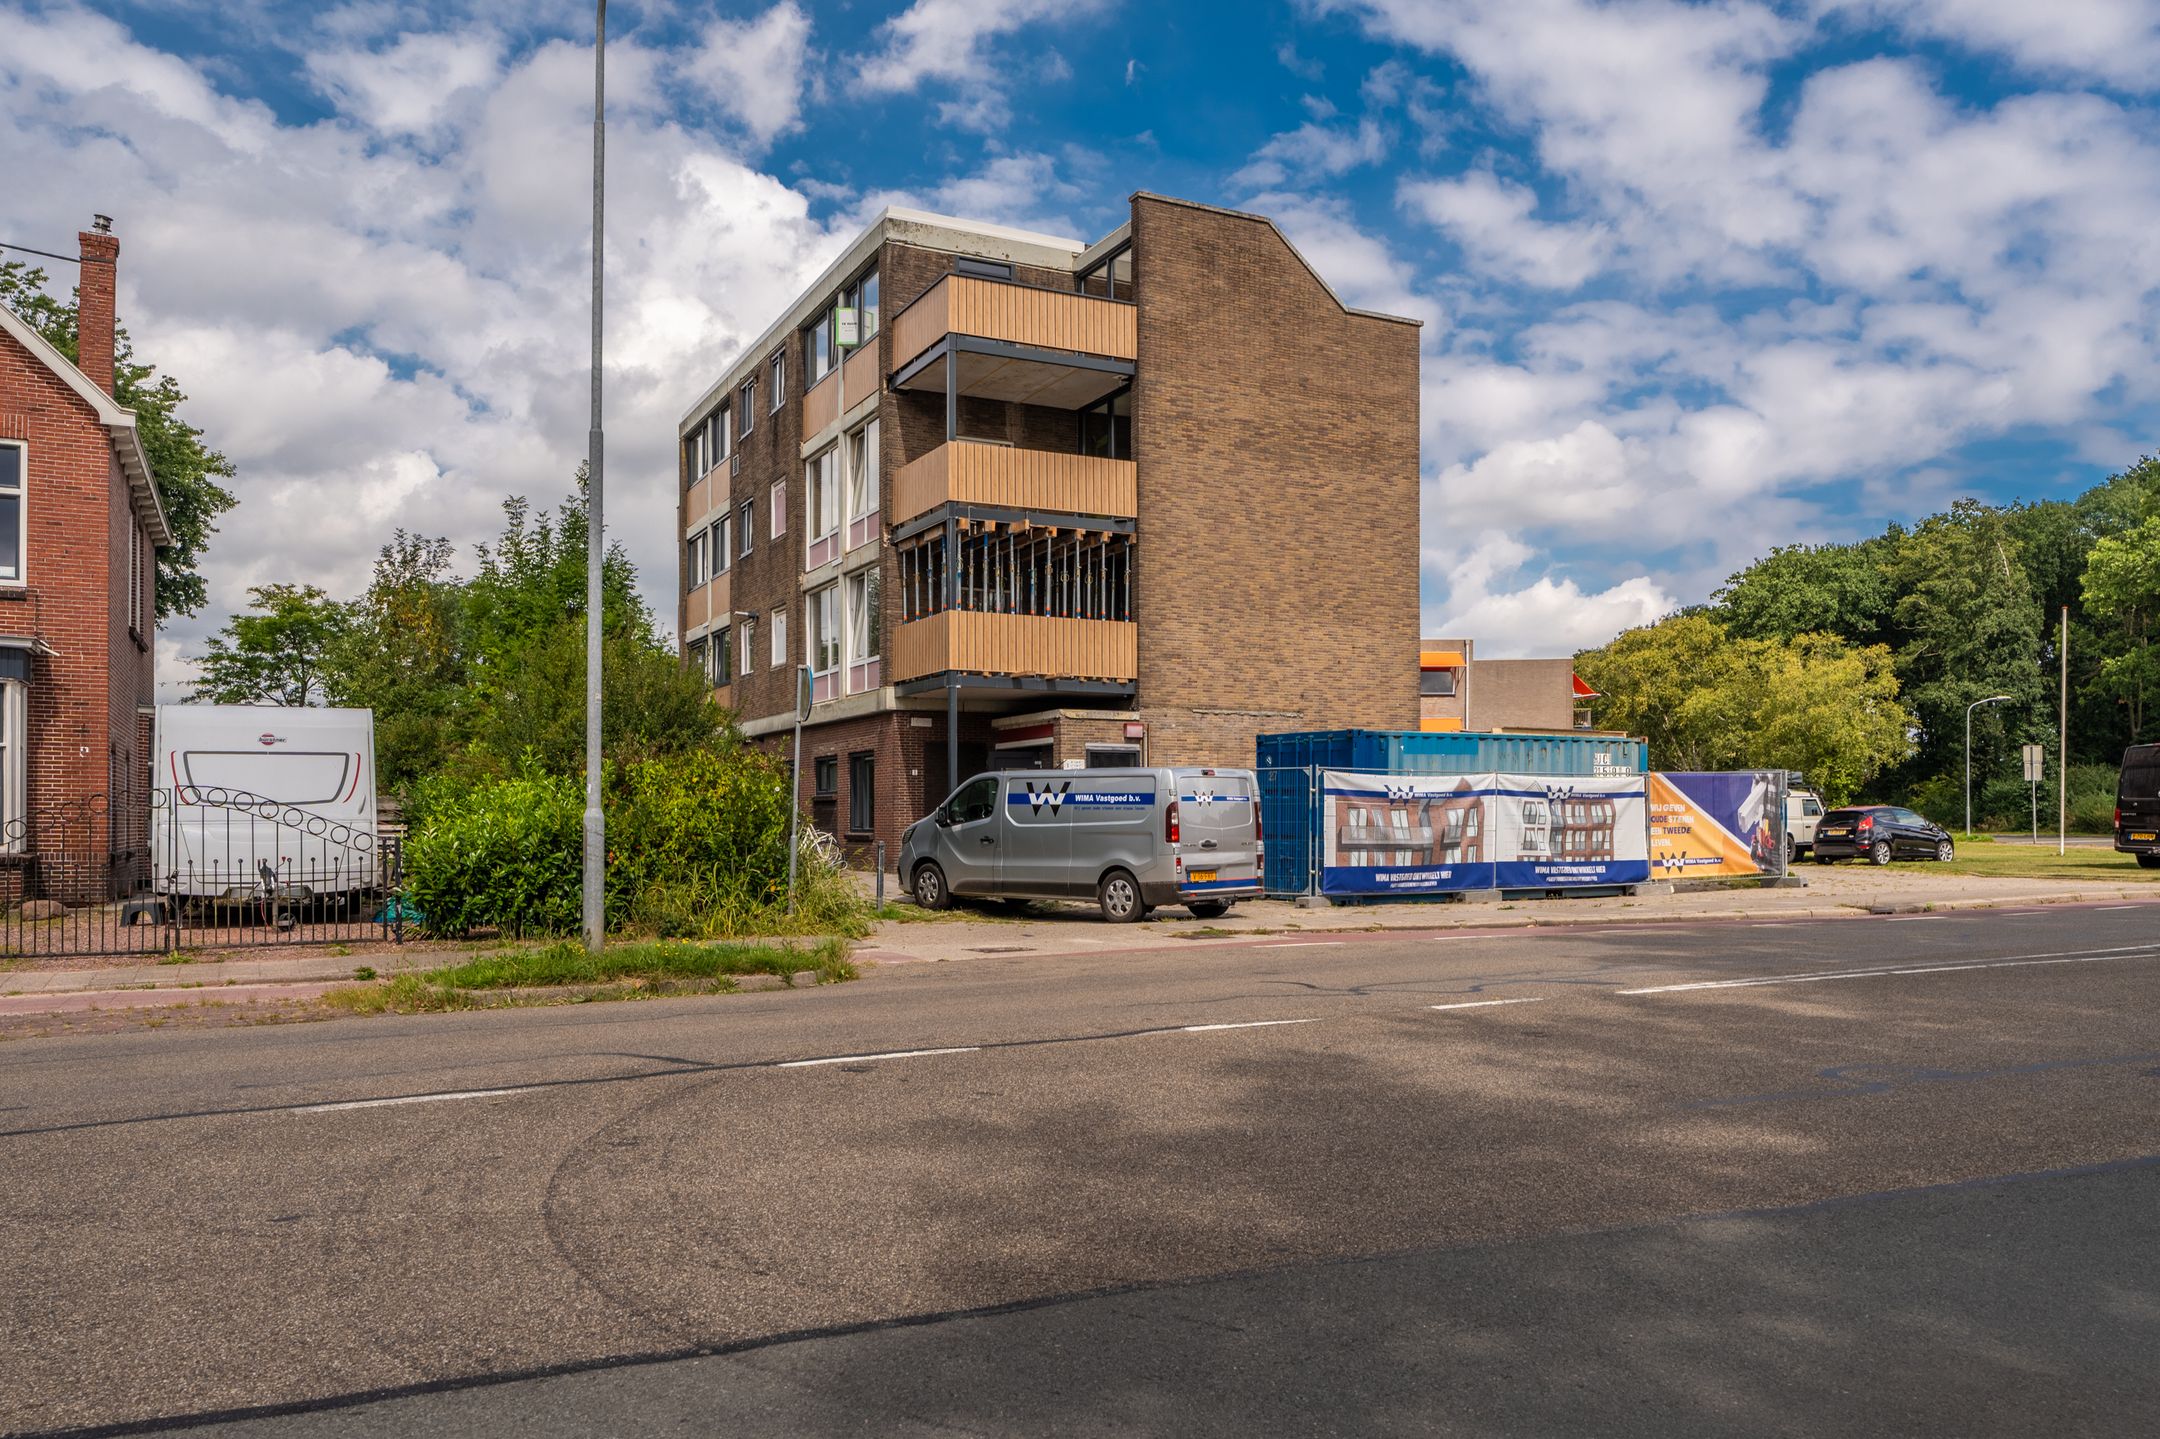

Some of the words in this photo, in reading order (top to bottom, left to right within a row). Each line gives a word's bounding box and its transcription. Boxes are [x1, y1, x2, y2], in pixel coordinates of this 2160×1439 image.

[1026, 782, 1071, 817] W
[1075, 794, 1093, 802] WIMA
[1095, 794, 1126, 803] Vastgoed
[1128, 794, 1141, 802] b.v.
[1663, 804, 1685, 812] GEVEN
[1376, 873, 1389, 882] WIMA
